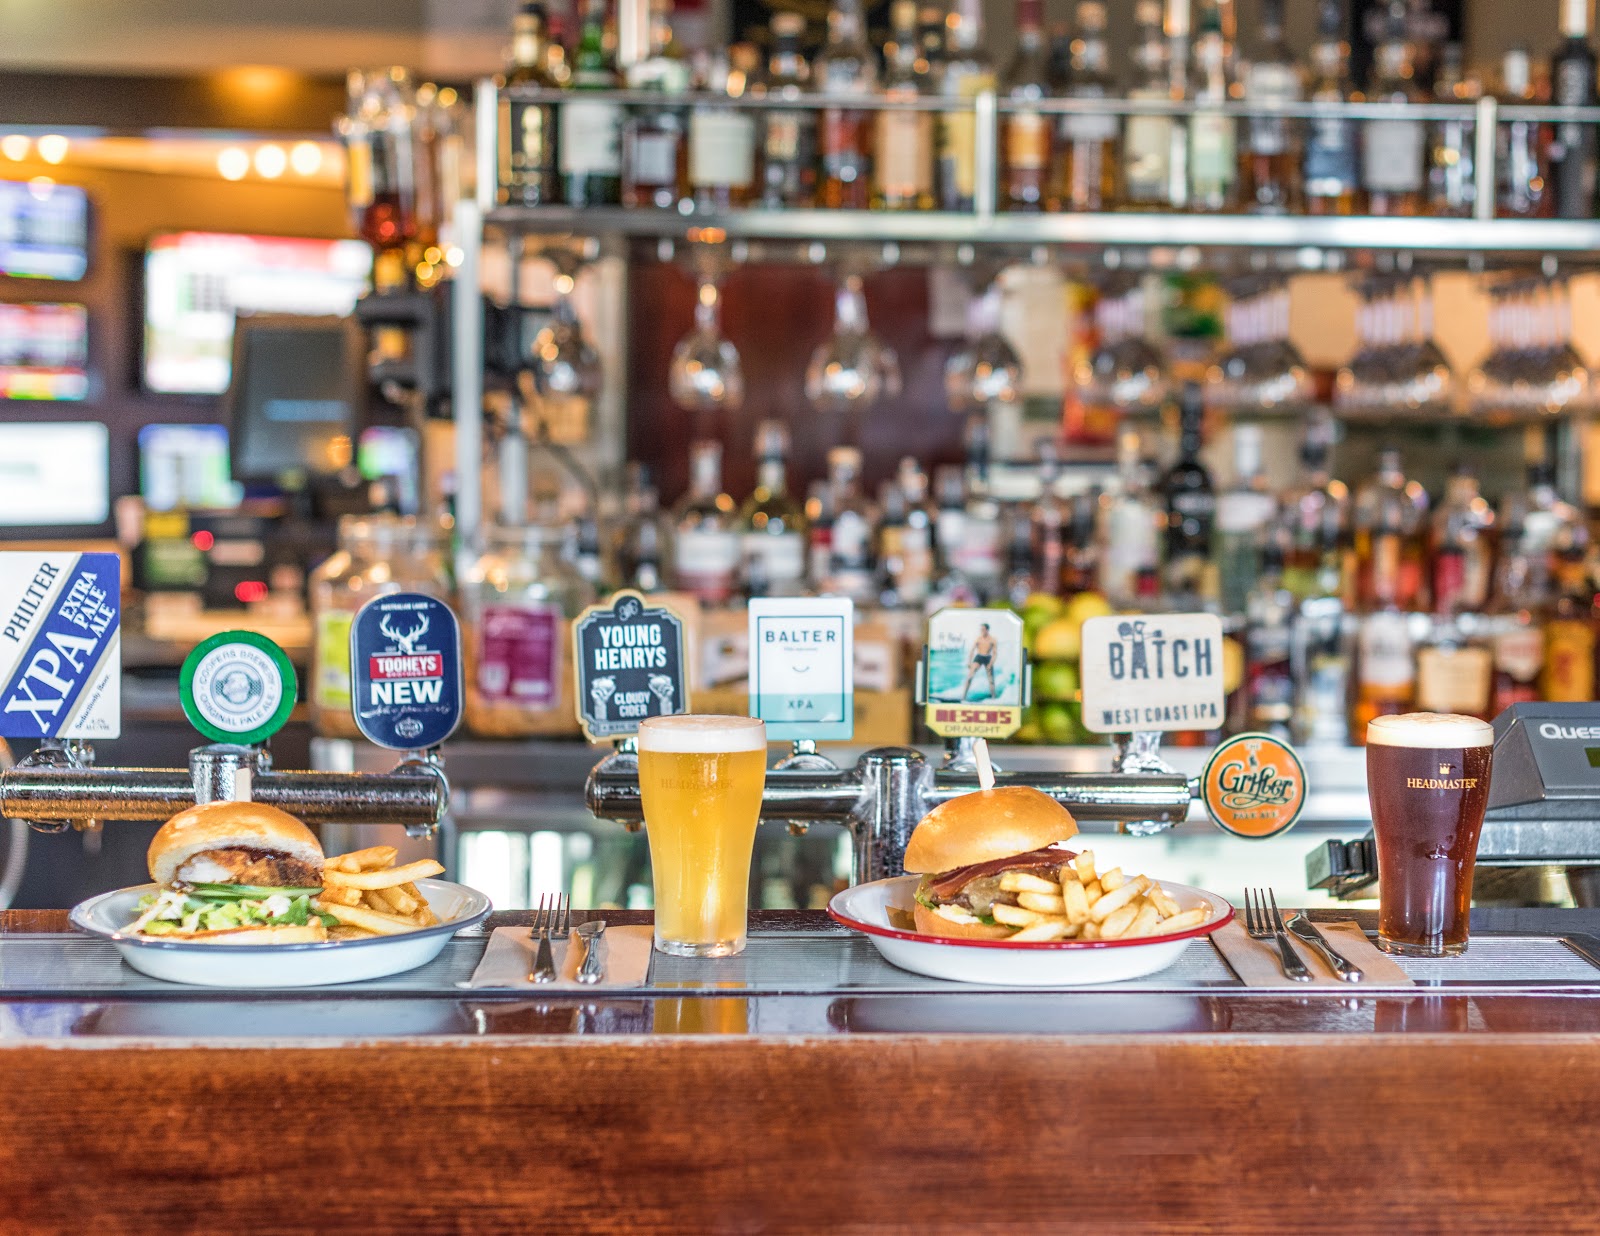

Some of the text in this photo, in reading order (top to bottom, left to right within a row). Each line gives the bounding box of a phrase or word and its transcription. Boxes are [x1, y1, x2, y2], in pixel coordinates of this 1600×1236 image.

[3, 561, 60, 643] PHILTER
[58, 571, 98, 621] EXTRA
[73, 586, 107, 630] PALE
[88, 603, 116, 638] ALE
[599, 624, 662, 648] YOUNG
[765, 630, 836, 643] BALTER
[376, 655, 437, 673] TOOHEYS
[594, 646, 667, 670] HENRYS
[1108, 638, 1213, 680] BATCH
[3, 631, 98, 735] XPA
[370, 680, 444, 705] NEW
[200, 694, 275, 726] ORIGINAL PALE ALE
[614, 691, 651, 705] CLOUDY
[787, 700, 814, 709] XPA
[619, 704, 648, 717] CIDER
[1102, 703, 1218, 725] WEST COAST IPA
[945, 725, 1001, 734] DRAUGHT
[1407, 777, 1477, 790] HEADMASTER
